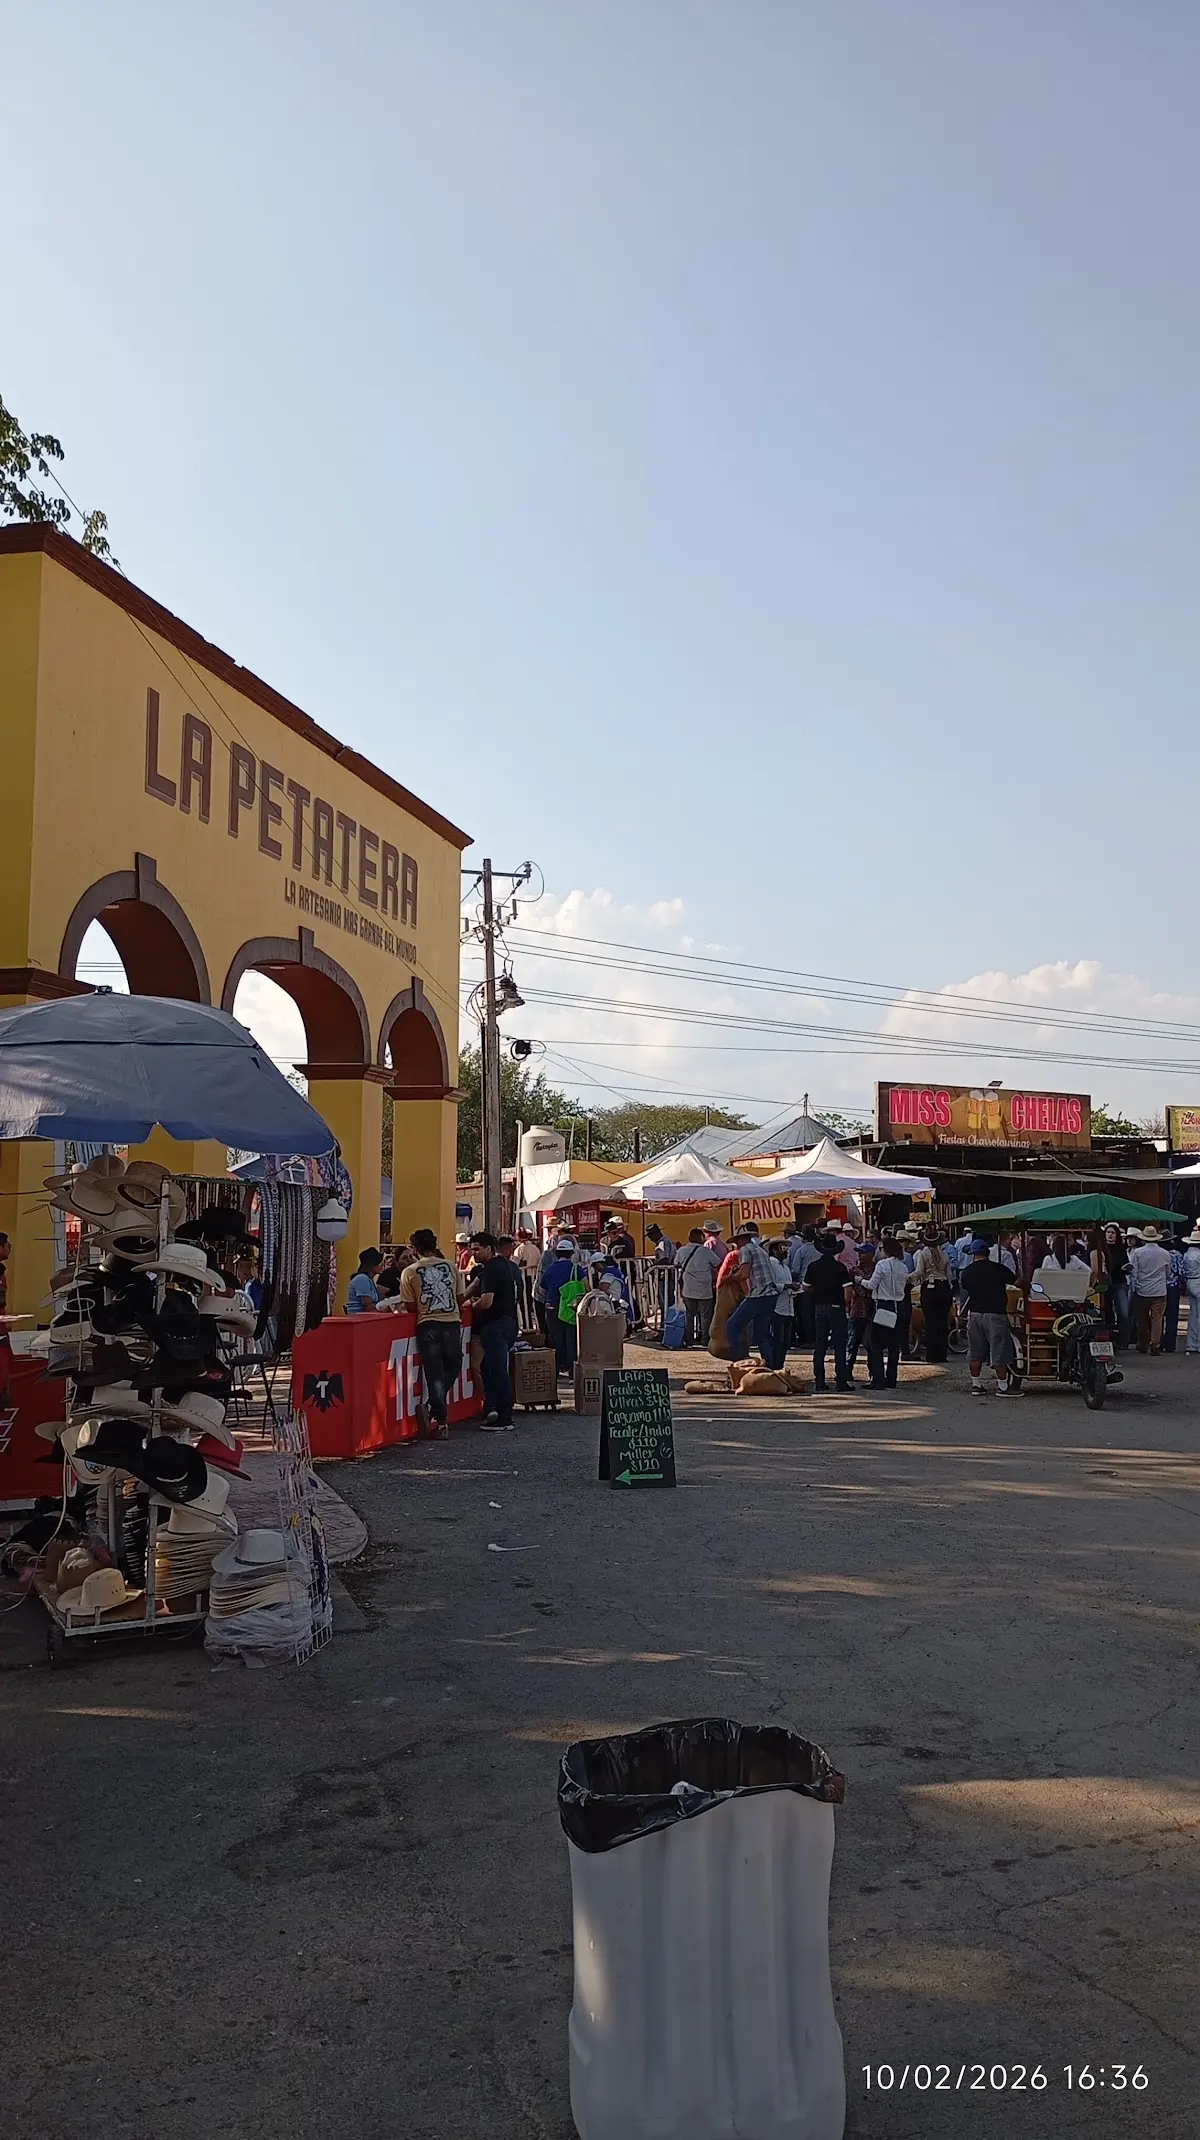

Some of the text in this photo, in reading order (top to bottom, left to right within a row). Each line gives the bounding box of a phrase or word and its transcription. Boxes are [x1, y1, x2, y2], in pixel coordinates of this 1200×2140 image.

[144, 686, 419, 931] LA PETATERA
[284, 877, 417, 964] LA ARTESANIA MAS GRANDE DEL MUNDO
[889, 1087, 1082, 1135] MISS CHELAS
[937, 1132, 1031, 1148] Fiestas Charrotaurinas
[618, 1370, 655, 1382] LATAS
[315, 1380, 330, 1399] T
[607, 1382, 669, 1397] Tecates $40
[646, 1395, 670, 1407] $40
[628, 1437, 658, 1450] $110
[619, 1447, 655, 1461] Miller
[630, 1458, 660, 1472] $120
